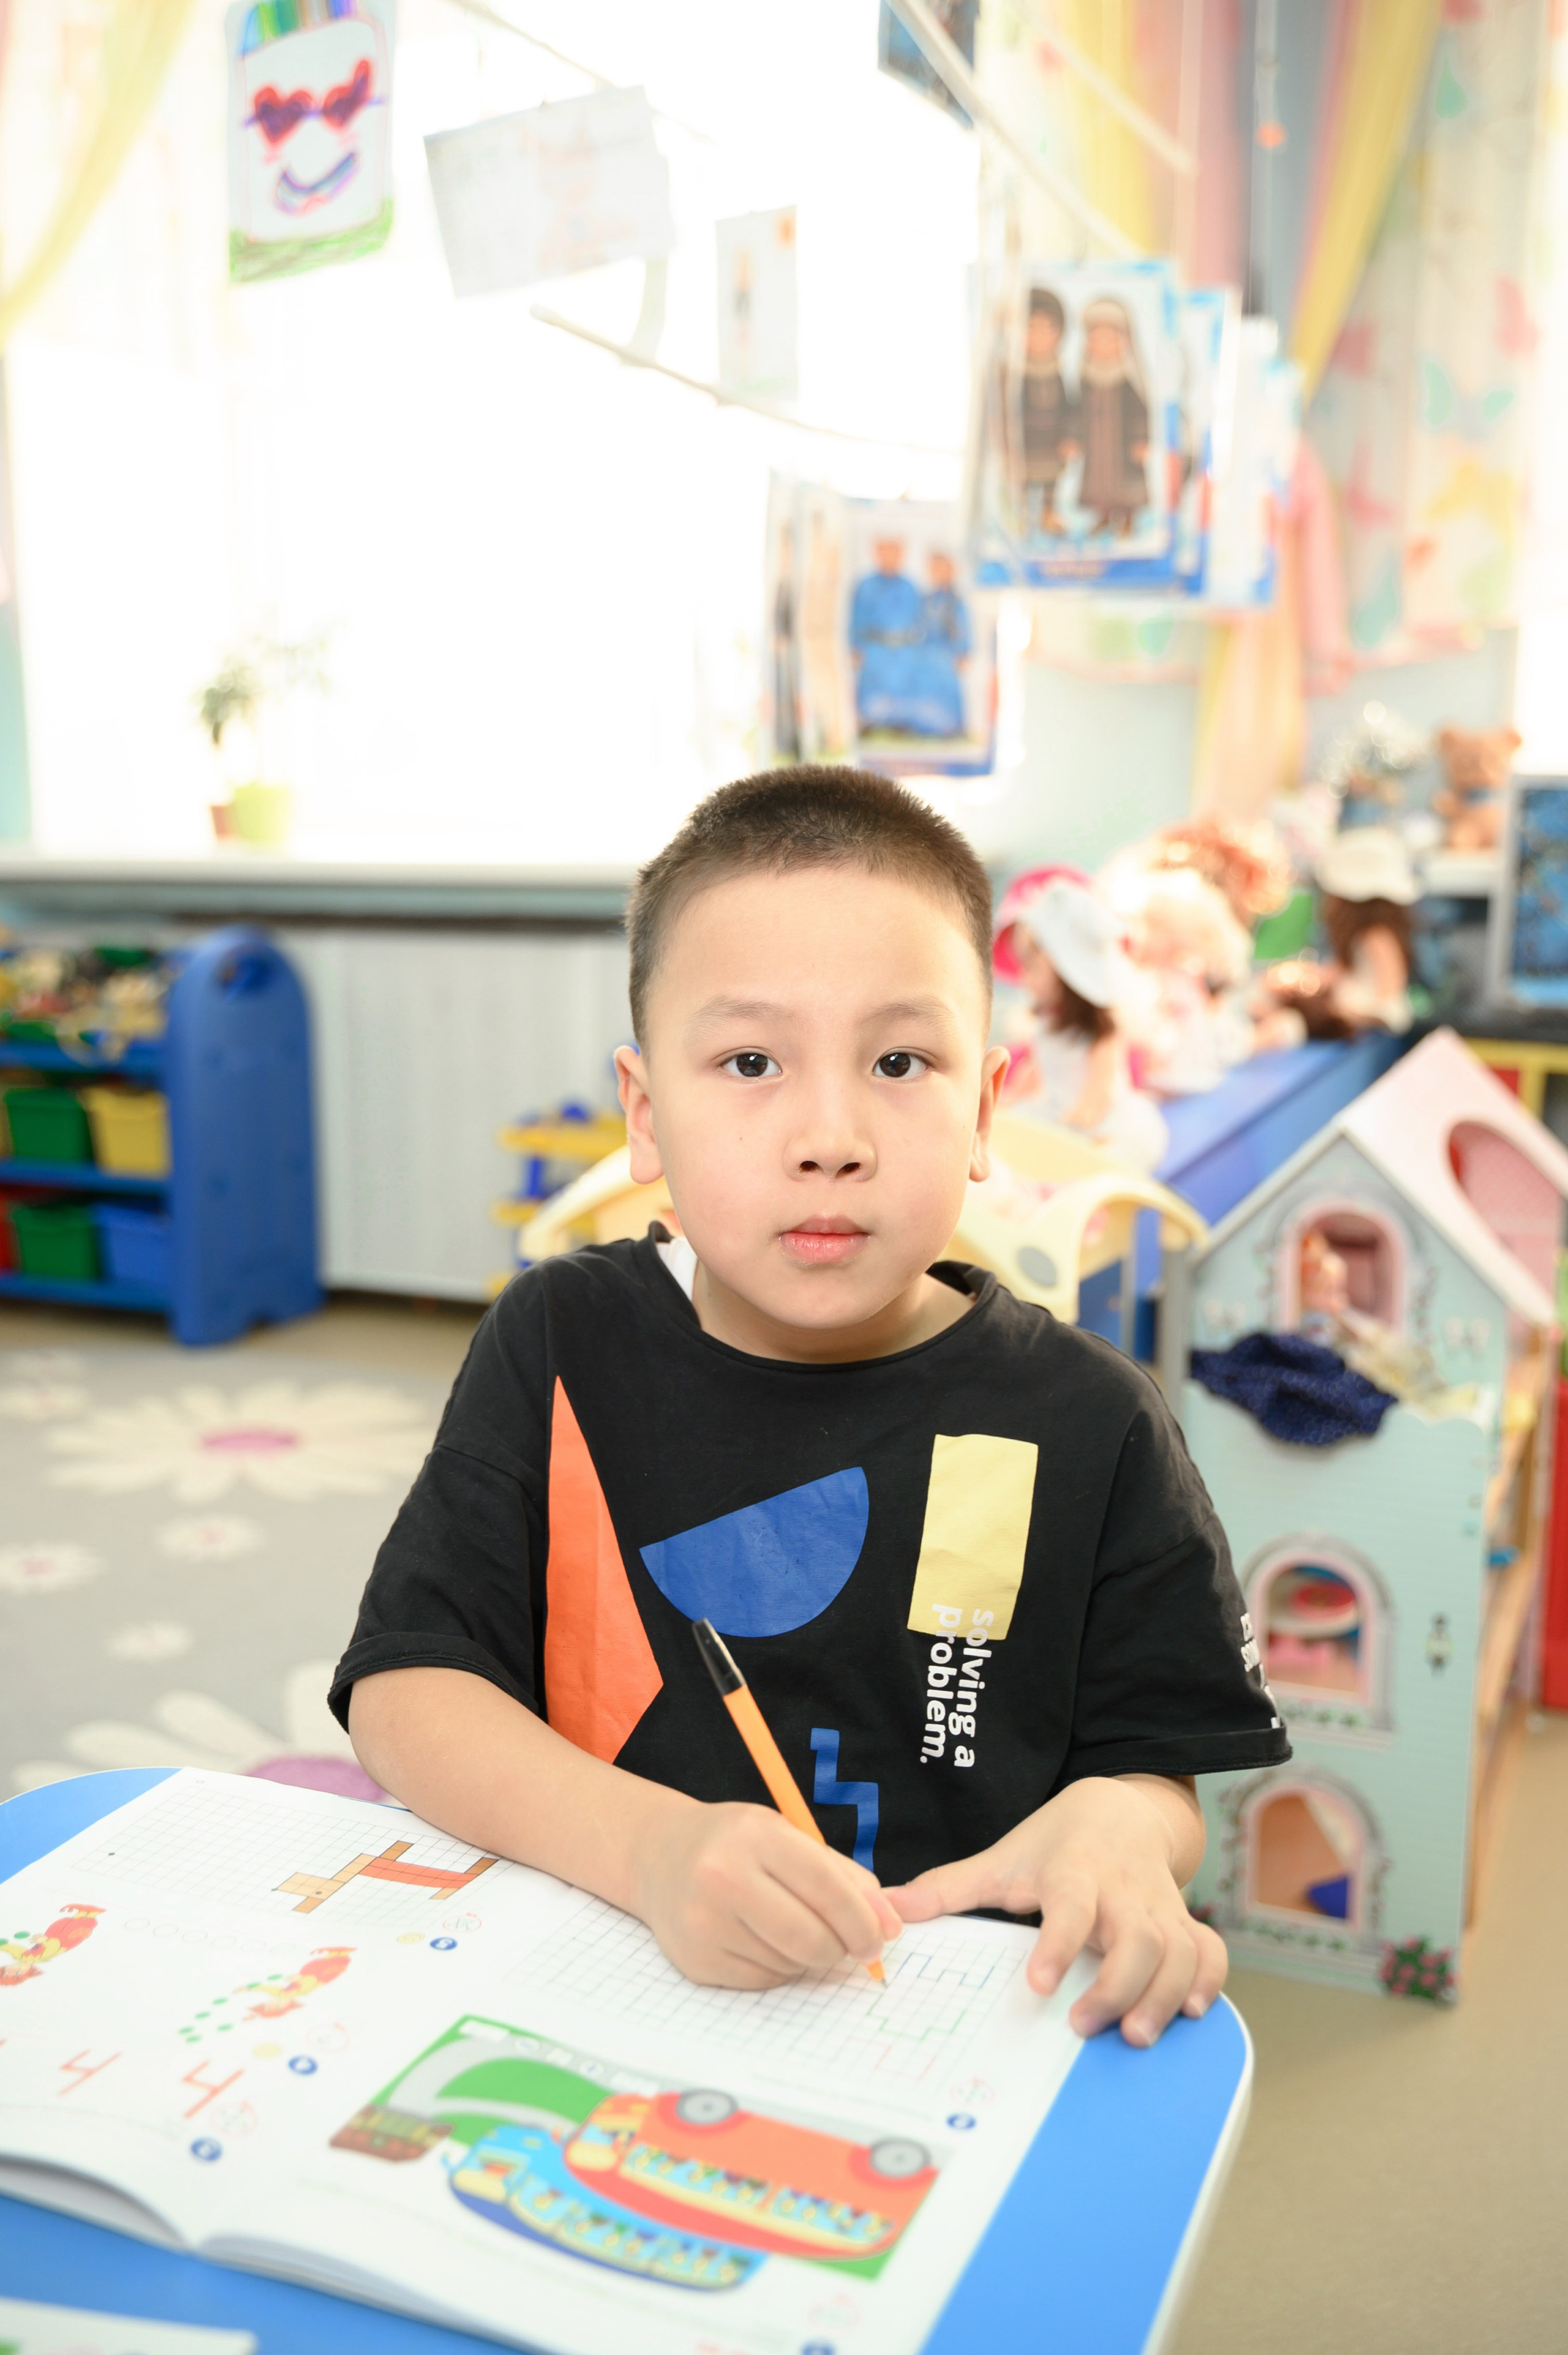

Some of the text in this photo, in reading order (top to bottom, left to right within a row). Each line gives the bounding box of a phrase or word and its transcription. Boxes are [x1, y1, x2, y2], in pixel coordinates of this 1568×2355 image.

[919, 1603, 963, 1764] problem.
[948, 1609, 994, 1767] solving a
